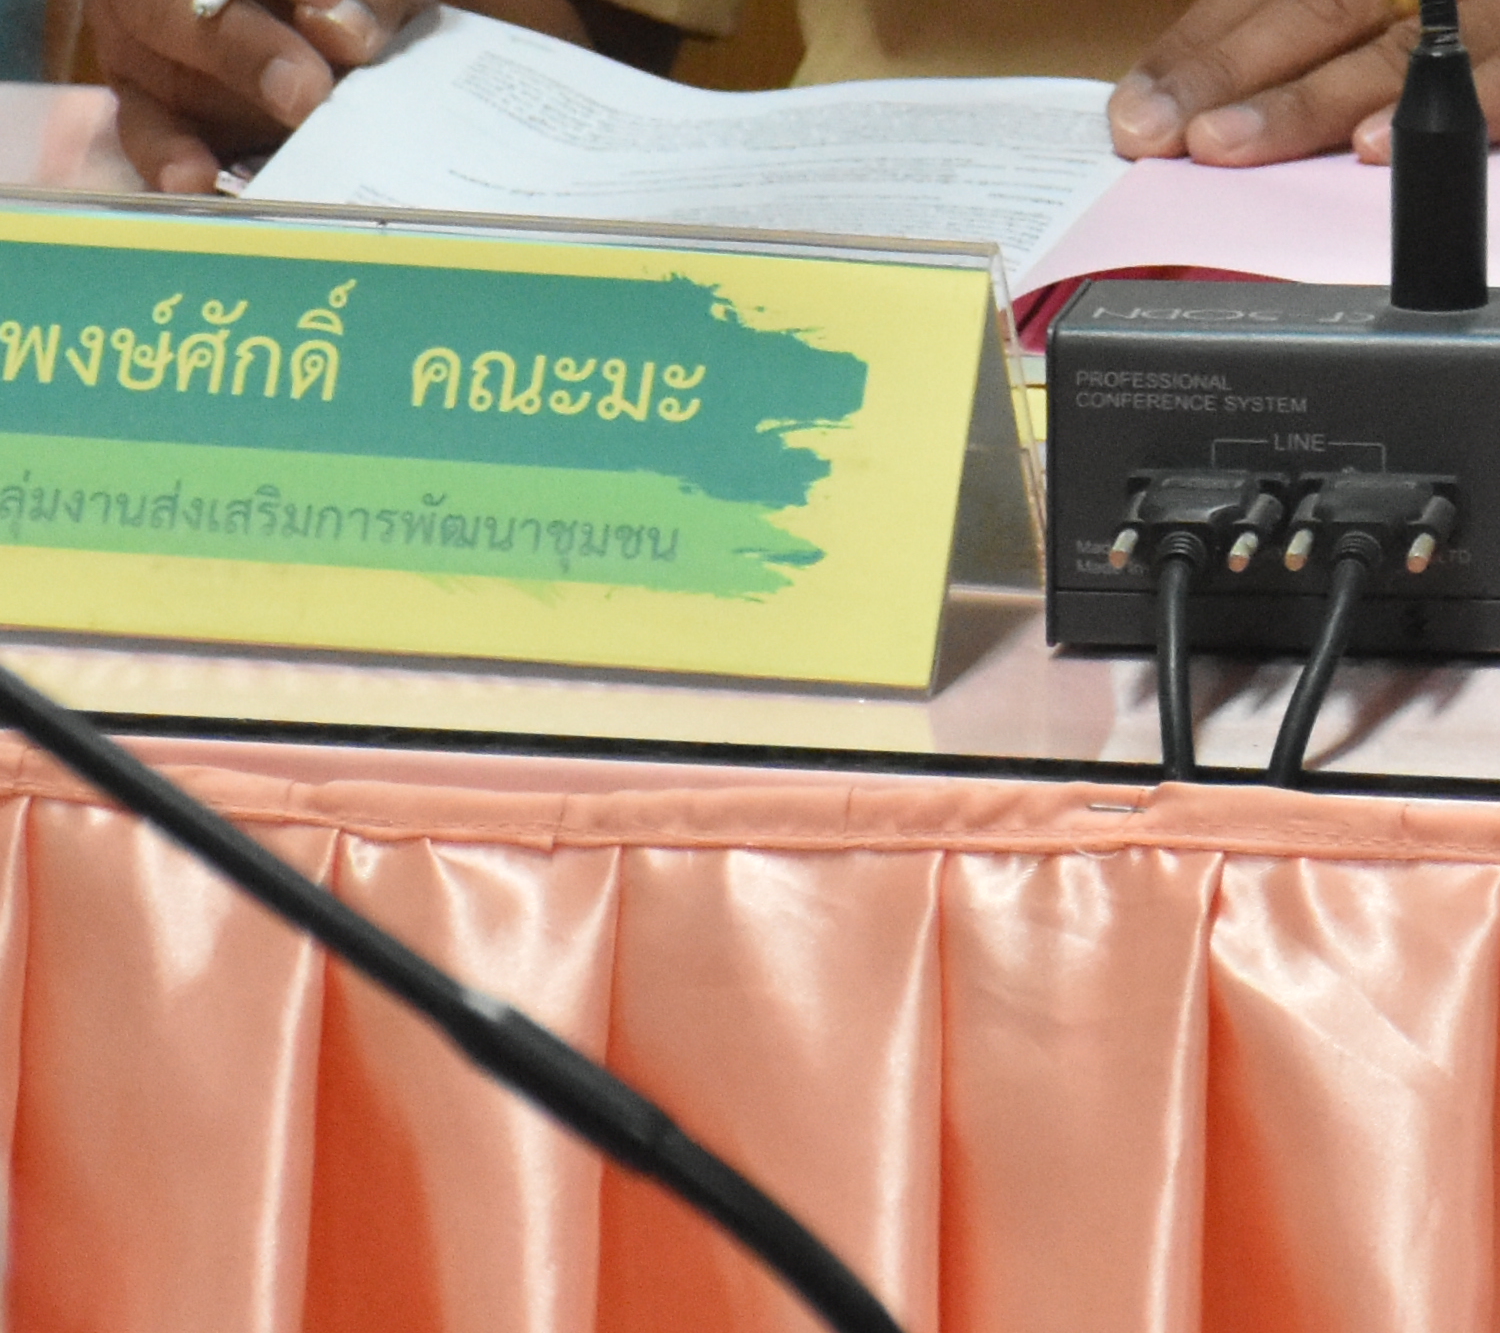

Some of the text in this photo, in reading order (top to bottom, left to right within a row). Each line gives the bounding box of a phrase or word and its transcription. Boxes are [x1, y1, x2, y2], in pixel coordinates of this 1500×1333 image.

[411, 346, 707, 423] คณะมะ
[1076, 370, 1232, 391] PROFESSIONAL
[1076, 392, 1308, 414] CONFERENCE SYSTEM
[1274, 433, 1326, 452] LINE
